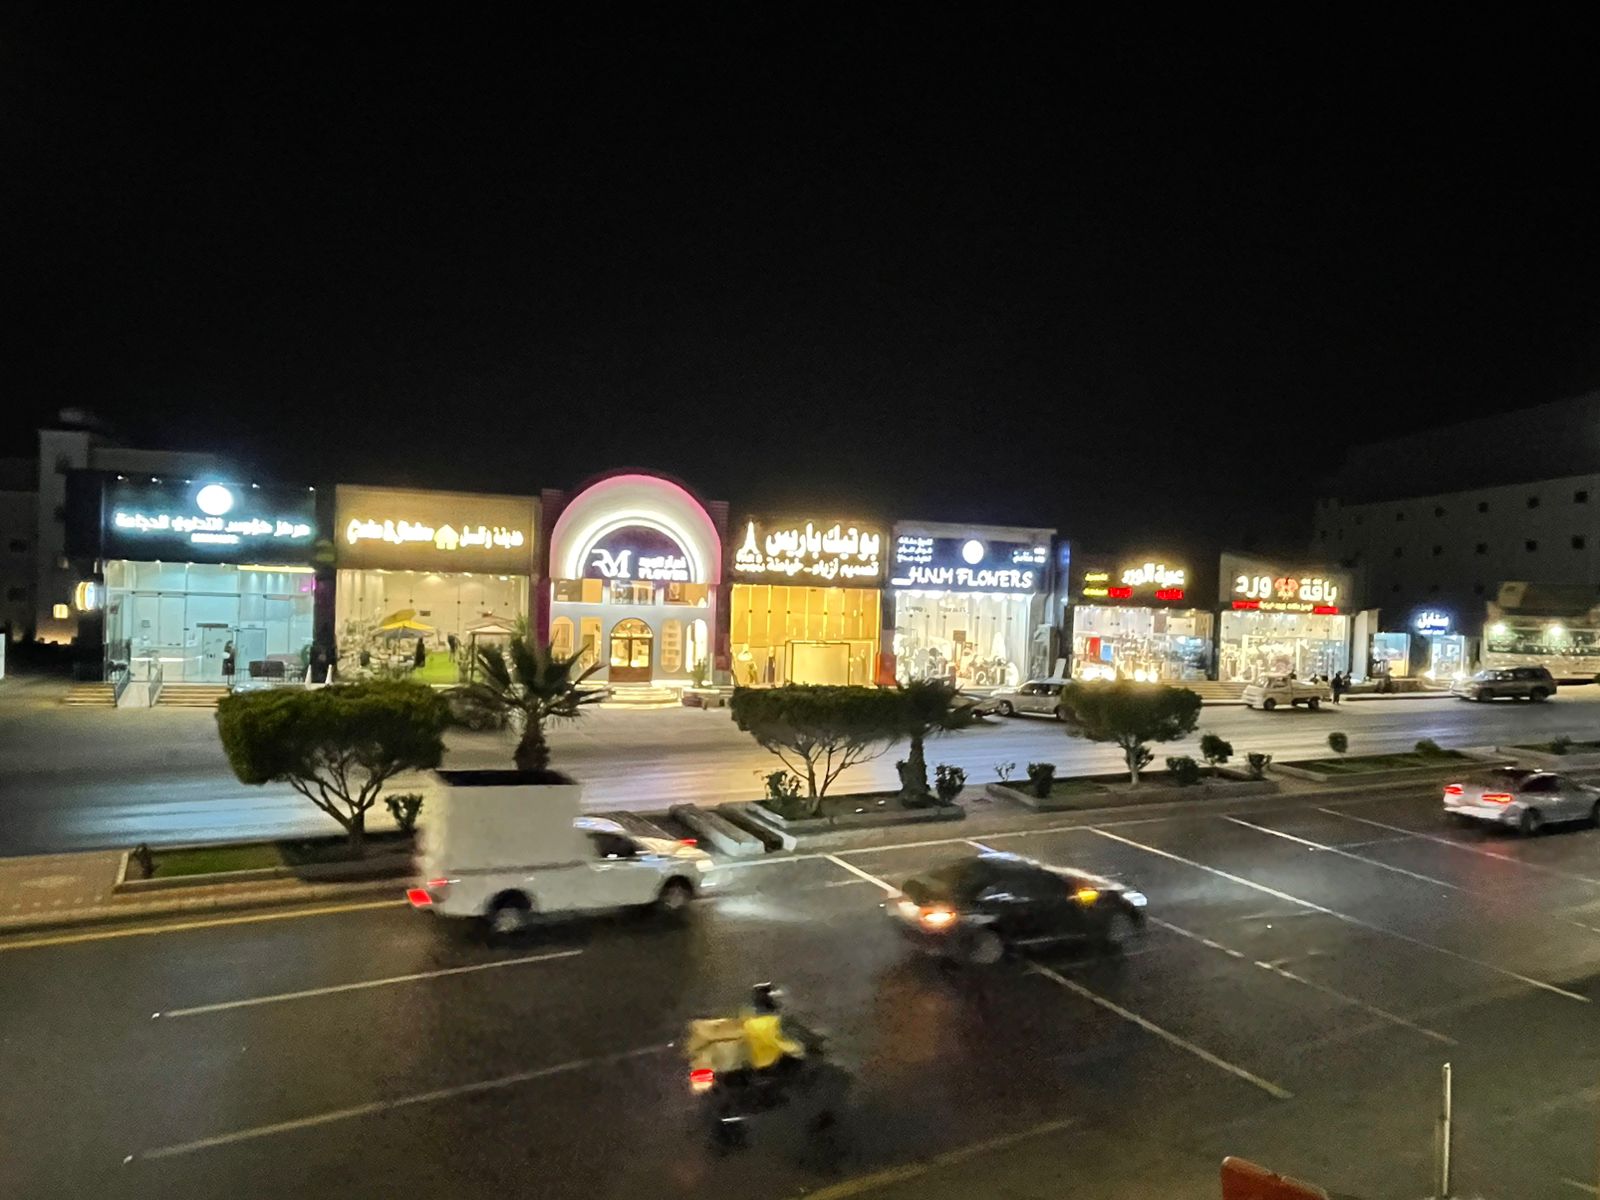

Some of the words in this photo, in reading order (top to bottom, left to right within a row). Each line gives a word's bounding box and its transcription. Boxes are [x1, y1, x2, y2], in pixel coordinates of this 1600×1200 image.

[765, 522, 822, 559] باريس
[822, 523, 880, 562] بوتيك
[840, 561, 879, 578] تصميم
[955, 567, 1033, 588] FLOWERS
[1235, 575, 1272, 599] ورد
[1299, 577, 1337, 606] باقة
